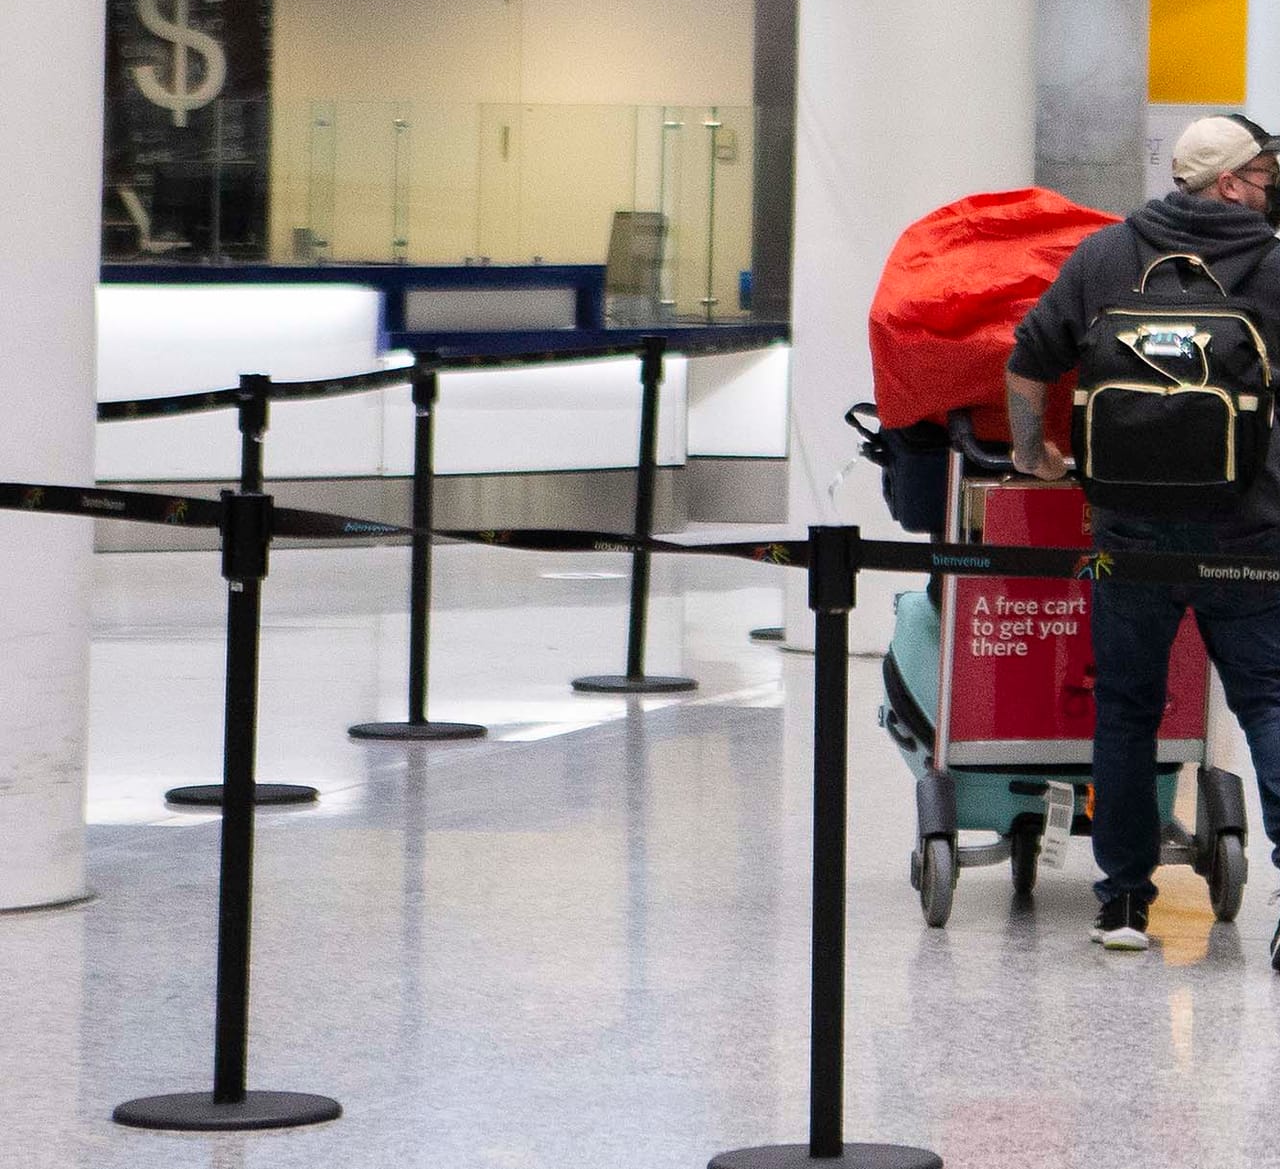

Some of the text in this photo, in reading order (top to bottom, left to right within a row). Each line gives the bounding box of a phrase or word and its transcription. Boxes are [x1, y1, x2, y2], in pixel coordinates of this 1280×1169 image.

[931, 553, 991, 570] bienvenue
[1198, 564, 1240, 581] Toronto
[973, 596, 1087, 615] A free cart
[971, 619, 1078, 640] to get you
[971, 637, 1028, 657] there
